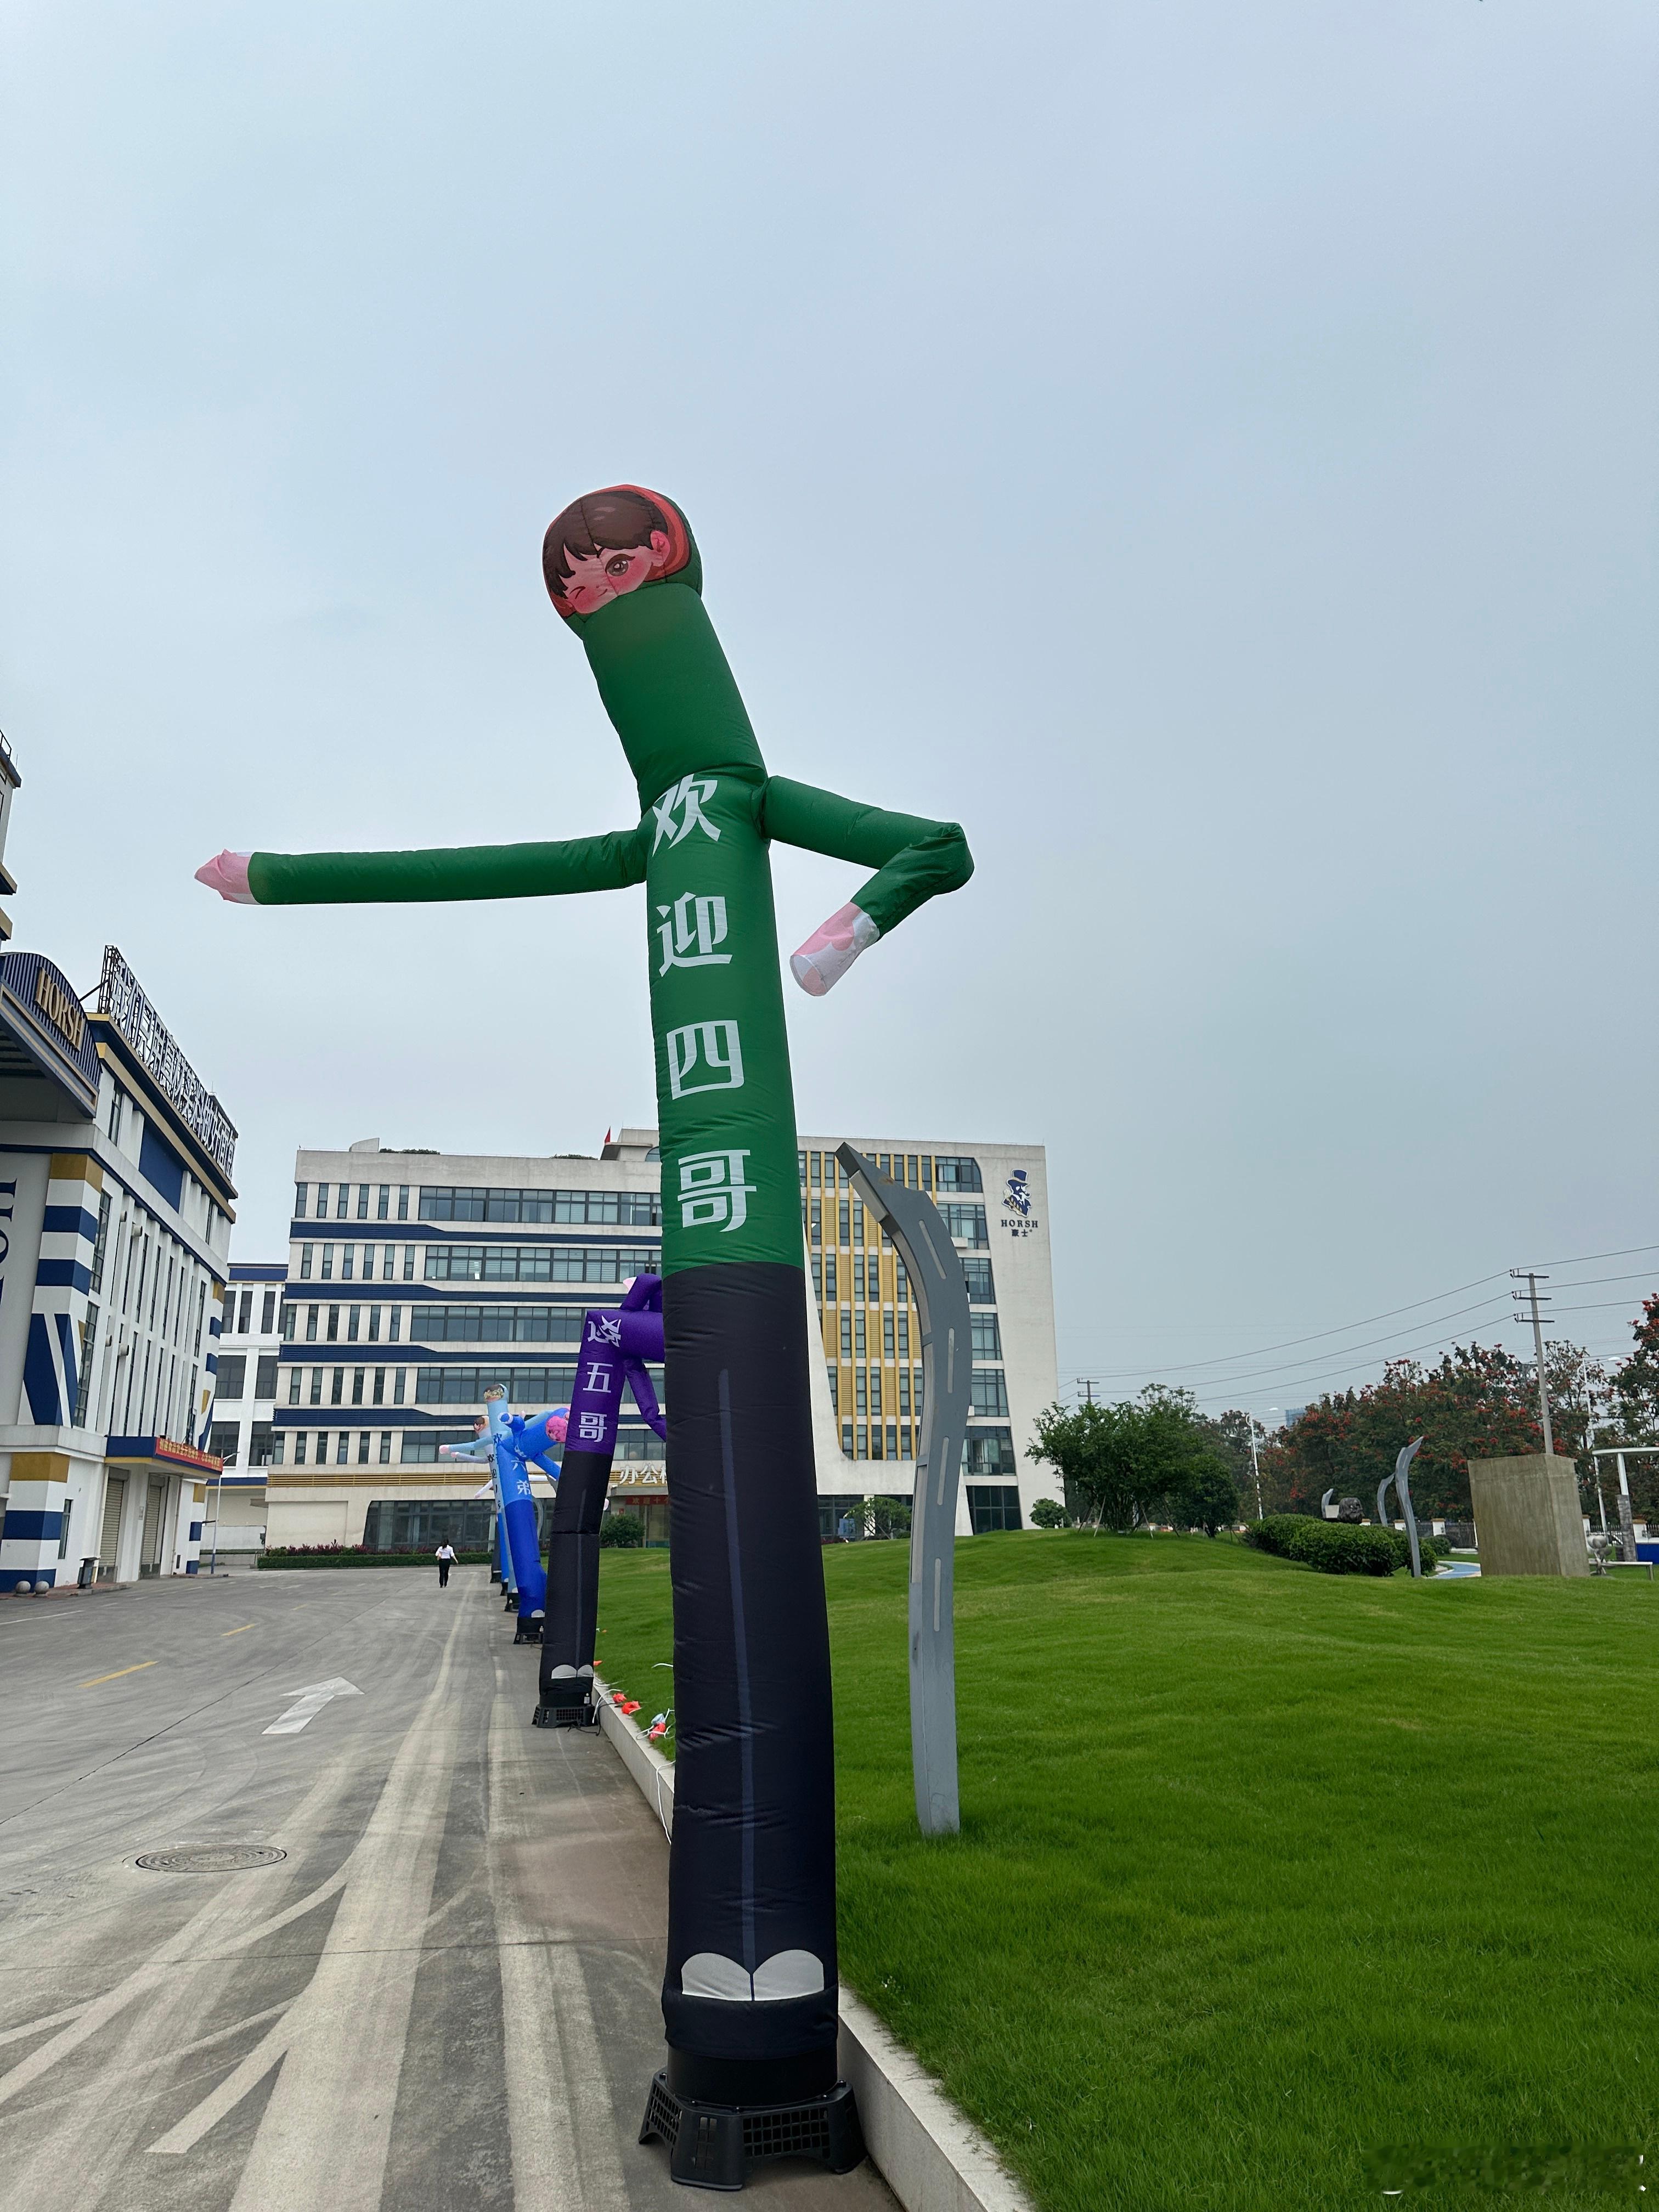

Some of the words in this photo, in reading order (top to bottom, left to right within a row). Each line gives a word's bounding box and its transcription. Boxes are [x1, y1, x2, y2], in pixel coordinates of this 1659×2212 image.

[35, 967, 86, 1053] HORSH
[652, 773, 757, 1233] 欢迎四哥
[1001, 1219, 1039, 1228] HORSH
